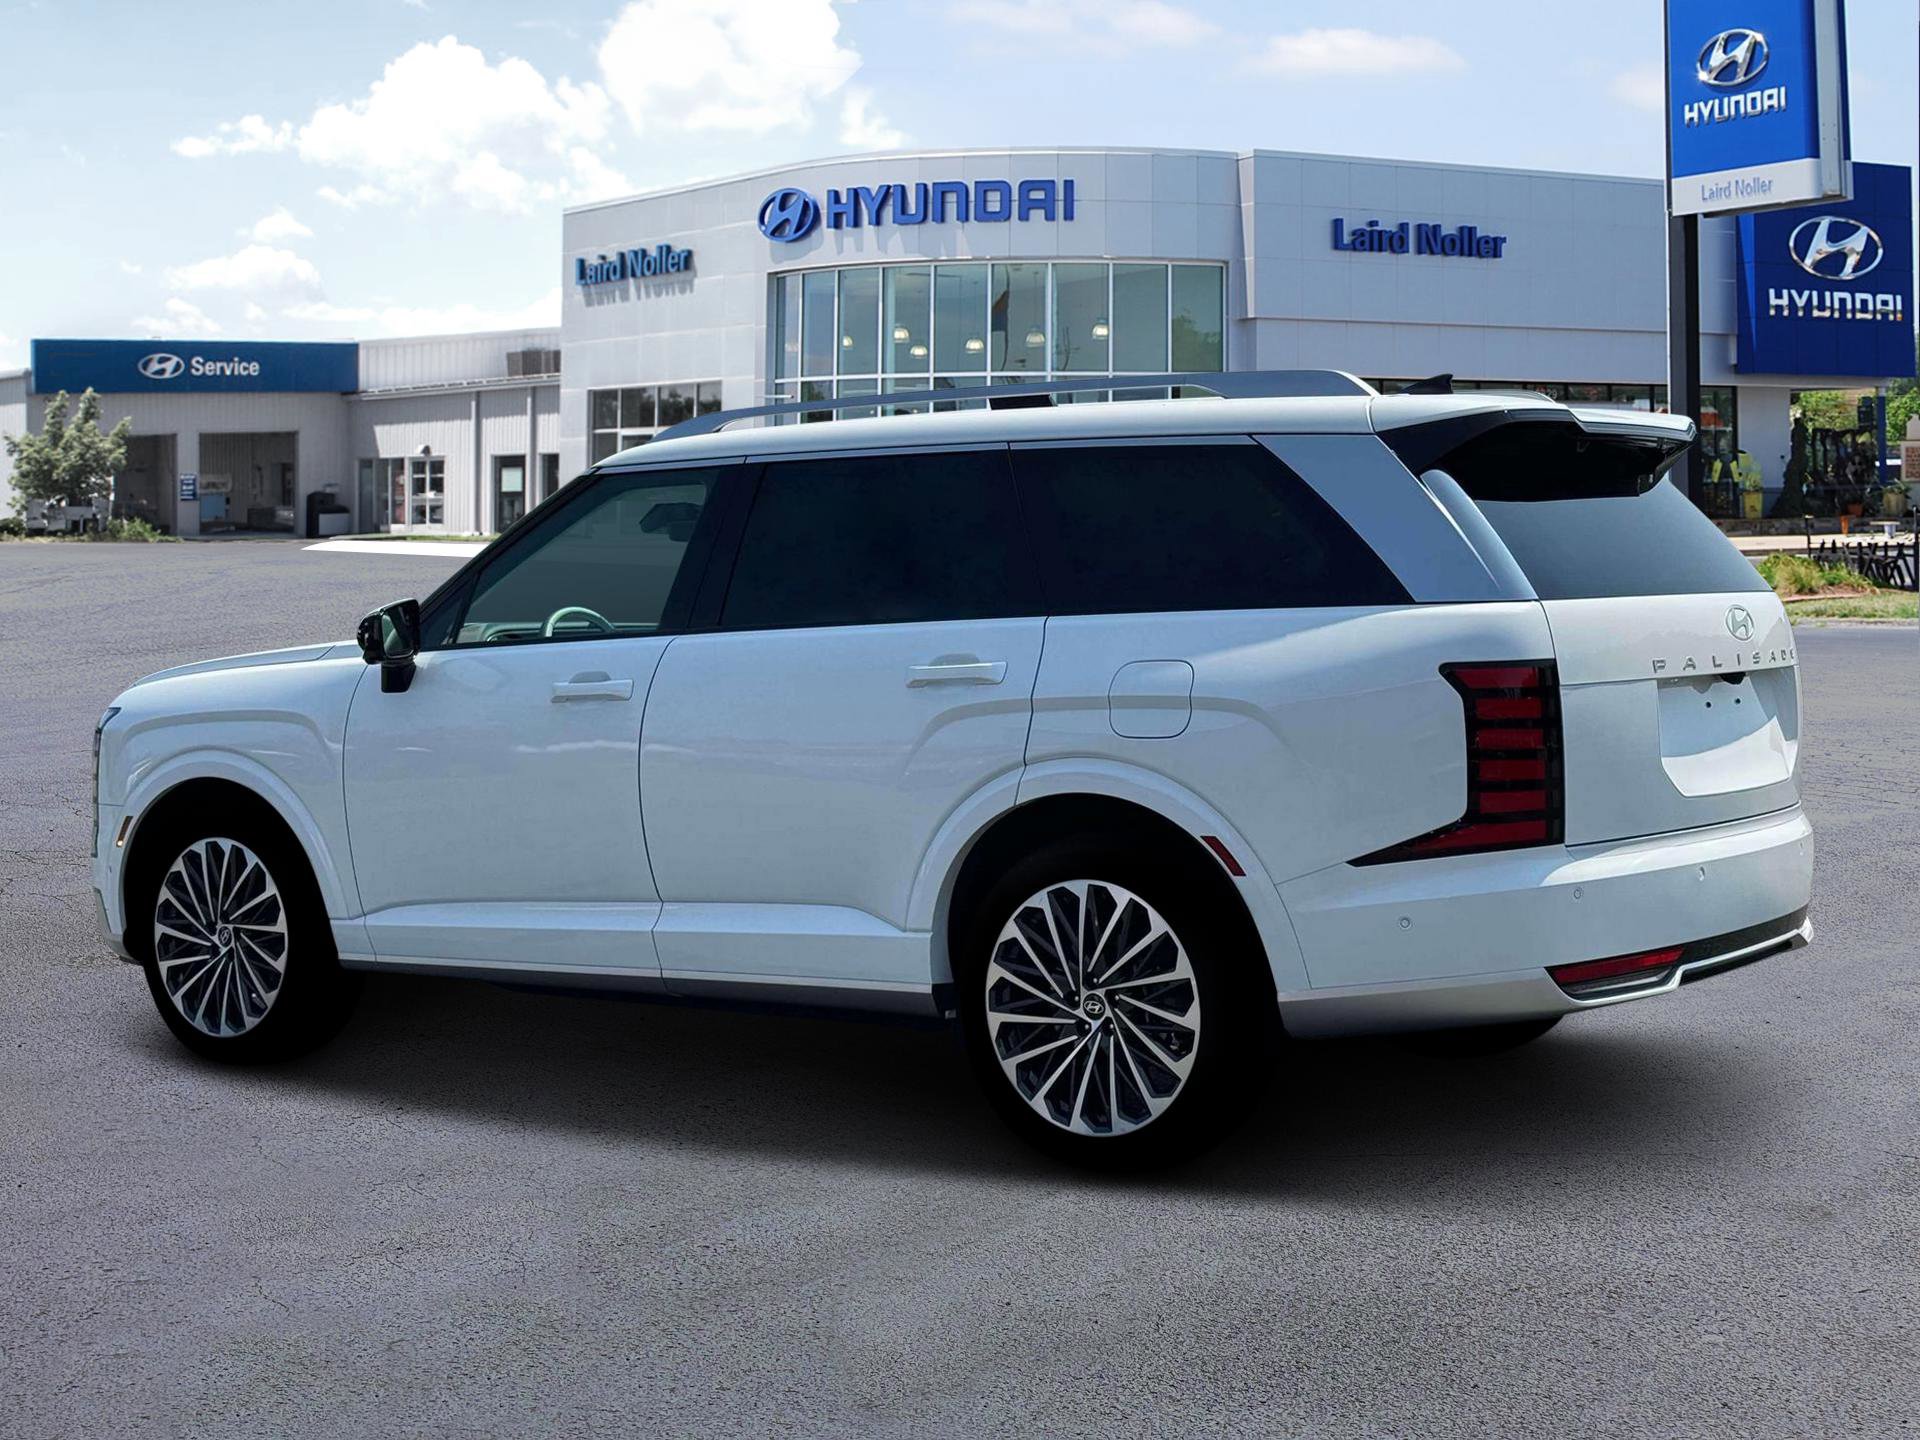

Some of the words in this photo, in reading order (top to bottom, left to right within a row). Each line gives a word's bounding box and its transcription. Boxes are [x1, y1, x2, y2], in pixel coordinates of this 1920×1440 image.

[1684, 86, 1786, 126] HYUNDAI
[827, 179, 1074, 229] HYUNDAI
[1701, 180, 1731, 201] Laird
[1735, 177, 1773, 197] Noller
[1333, 218, 1409, 254] Laird
[1416, 223, 1507, 258] Noller
[576, 252, 625, 285] Laird
[627, 244, 693, 278] Noller
[1768, 288, 1902, 321] HYUNDAI
[190, 356, 260, 376] Service
